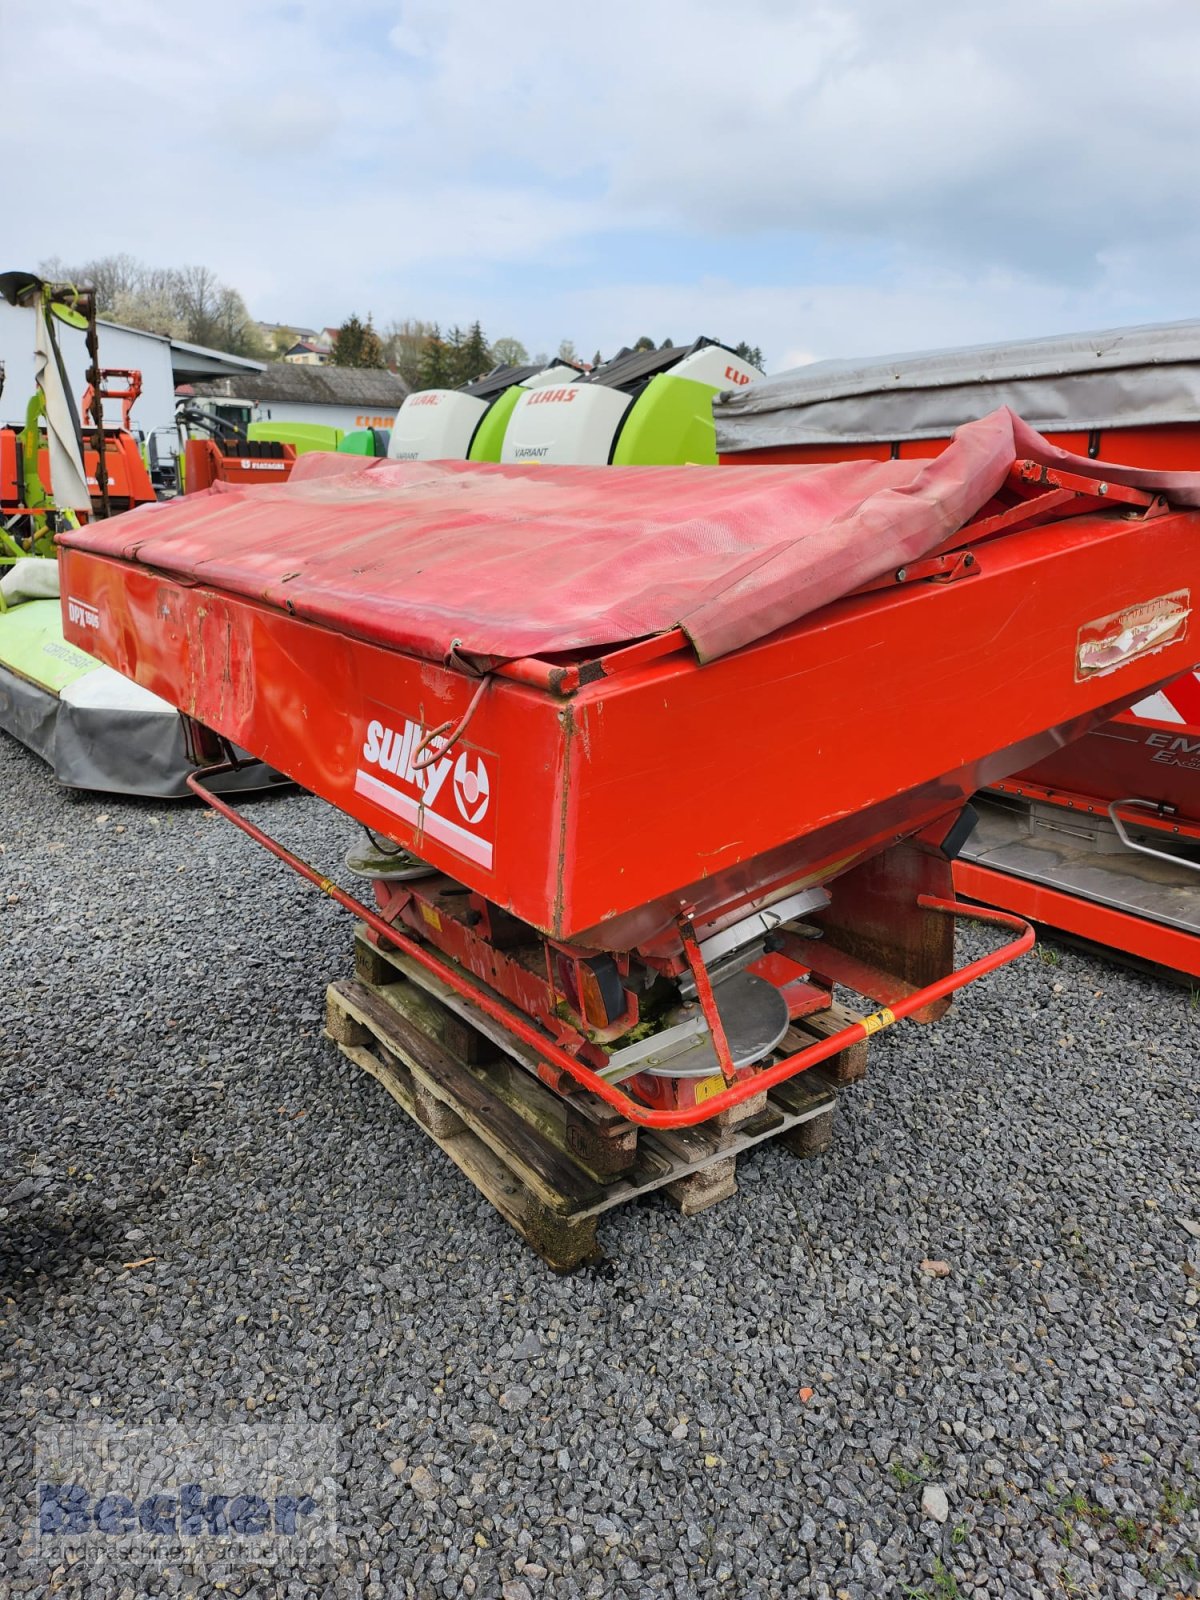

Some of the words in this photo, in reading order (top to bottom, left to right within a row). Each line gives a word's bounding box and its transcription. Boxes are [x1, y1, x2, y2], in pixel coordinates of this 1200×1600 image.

[409, 394, 446, 407] CLAA
[527, 388, 578, 405] CLAAS
[514, 448, 548, 457] VARIANT
[363, 719, 454, 807] sulky
